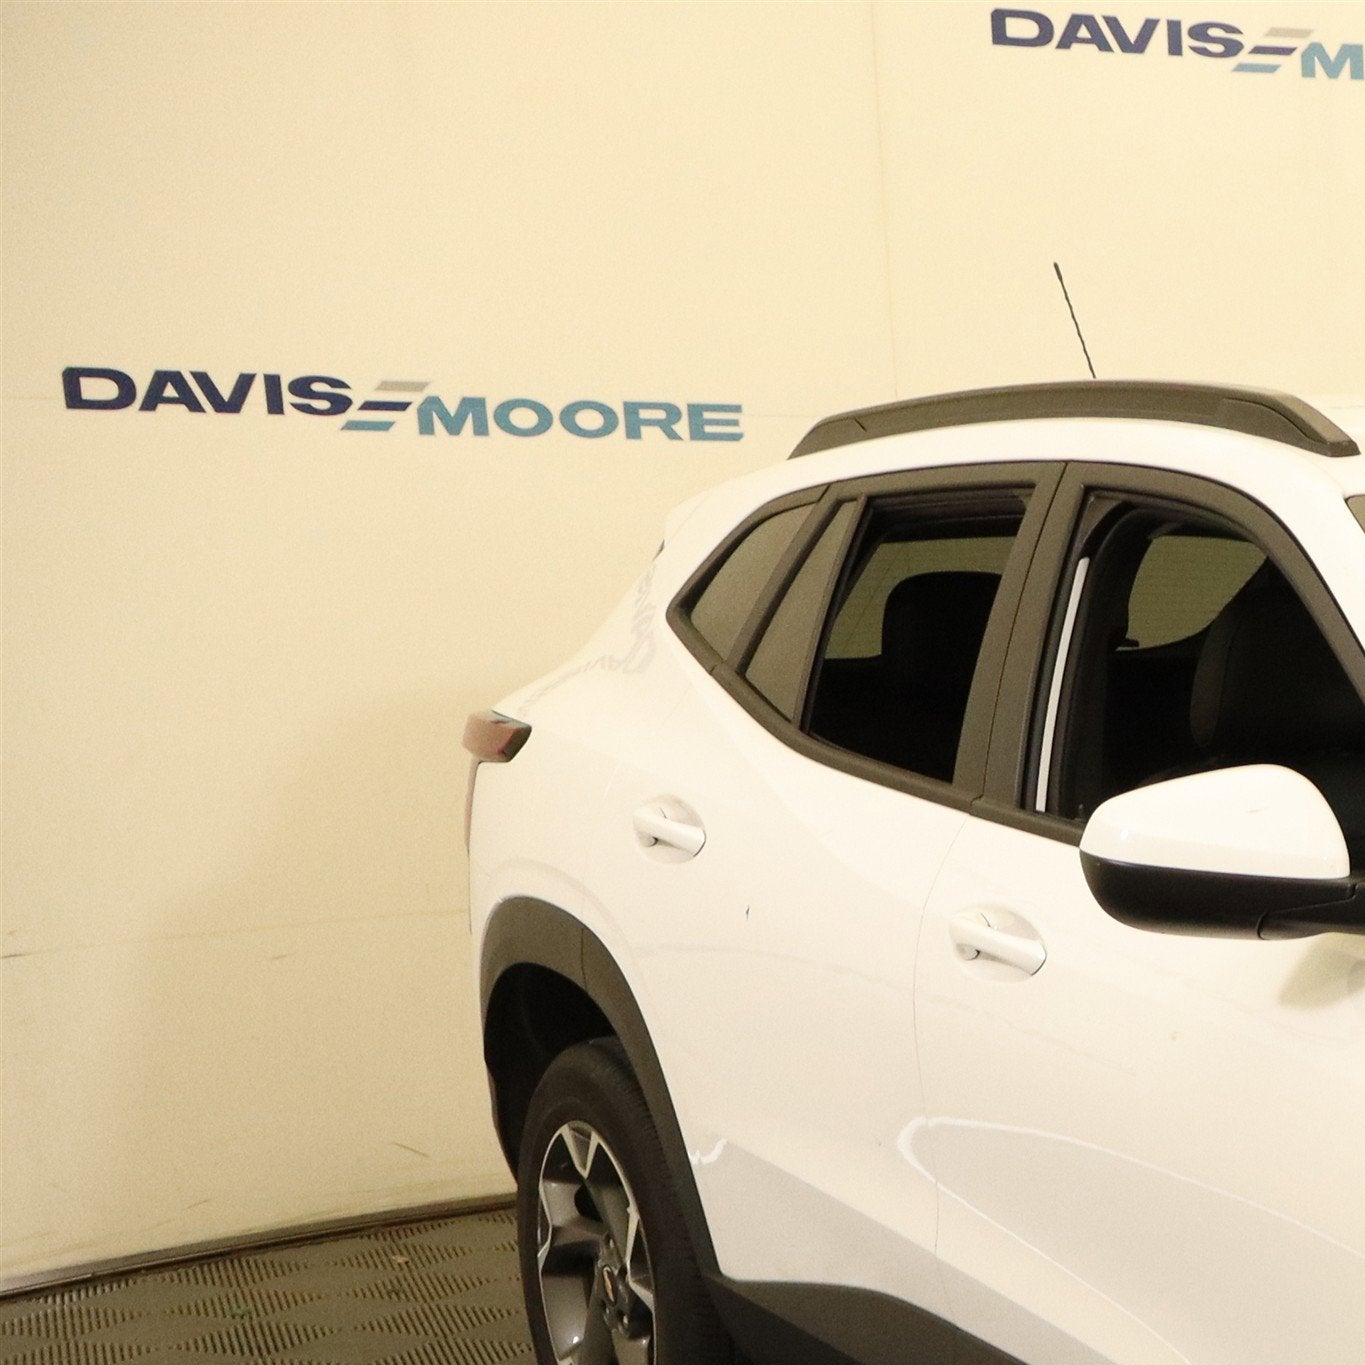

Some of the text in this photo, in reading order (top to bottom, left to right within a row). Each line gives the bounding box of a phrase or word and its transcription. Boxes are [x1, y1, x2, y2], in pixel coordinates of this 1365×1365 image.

[990, 7, 1245, 59] DAVIS
[61, 365, 744, 442] DAVIS MOORE
